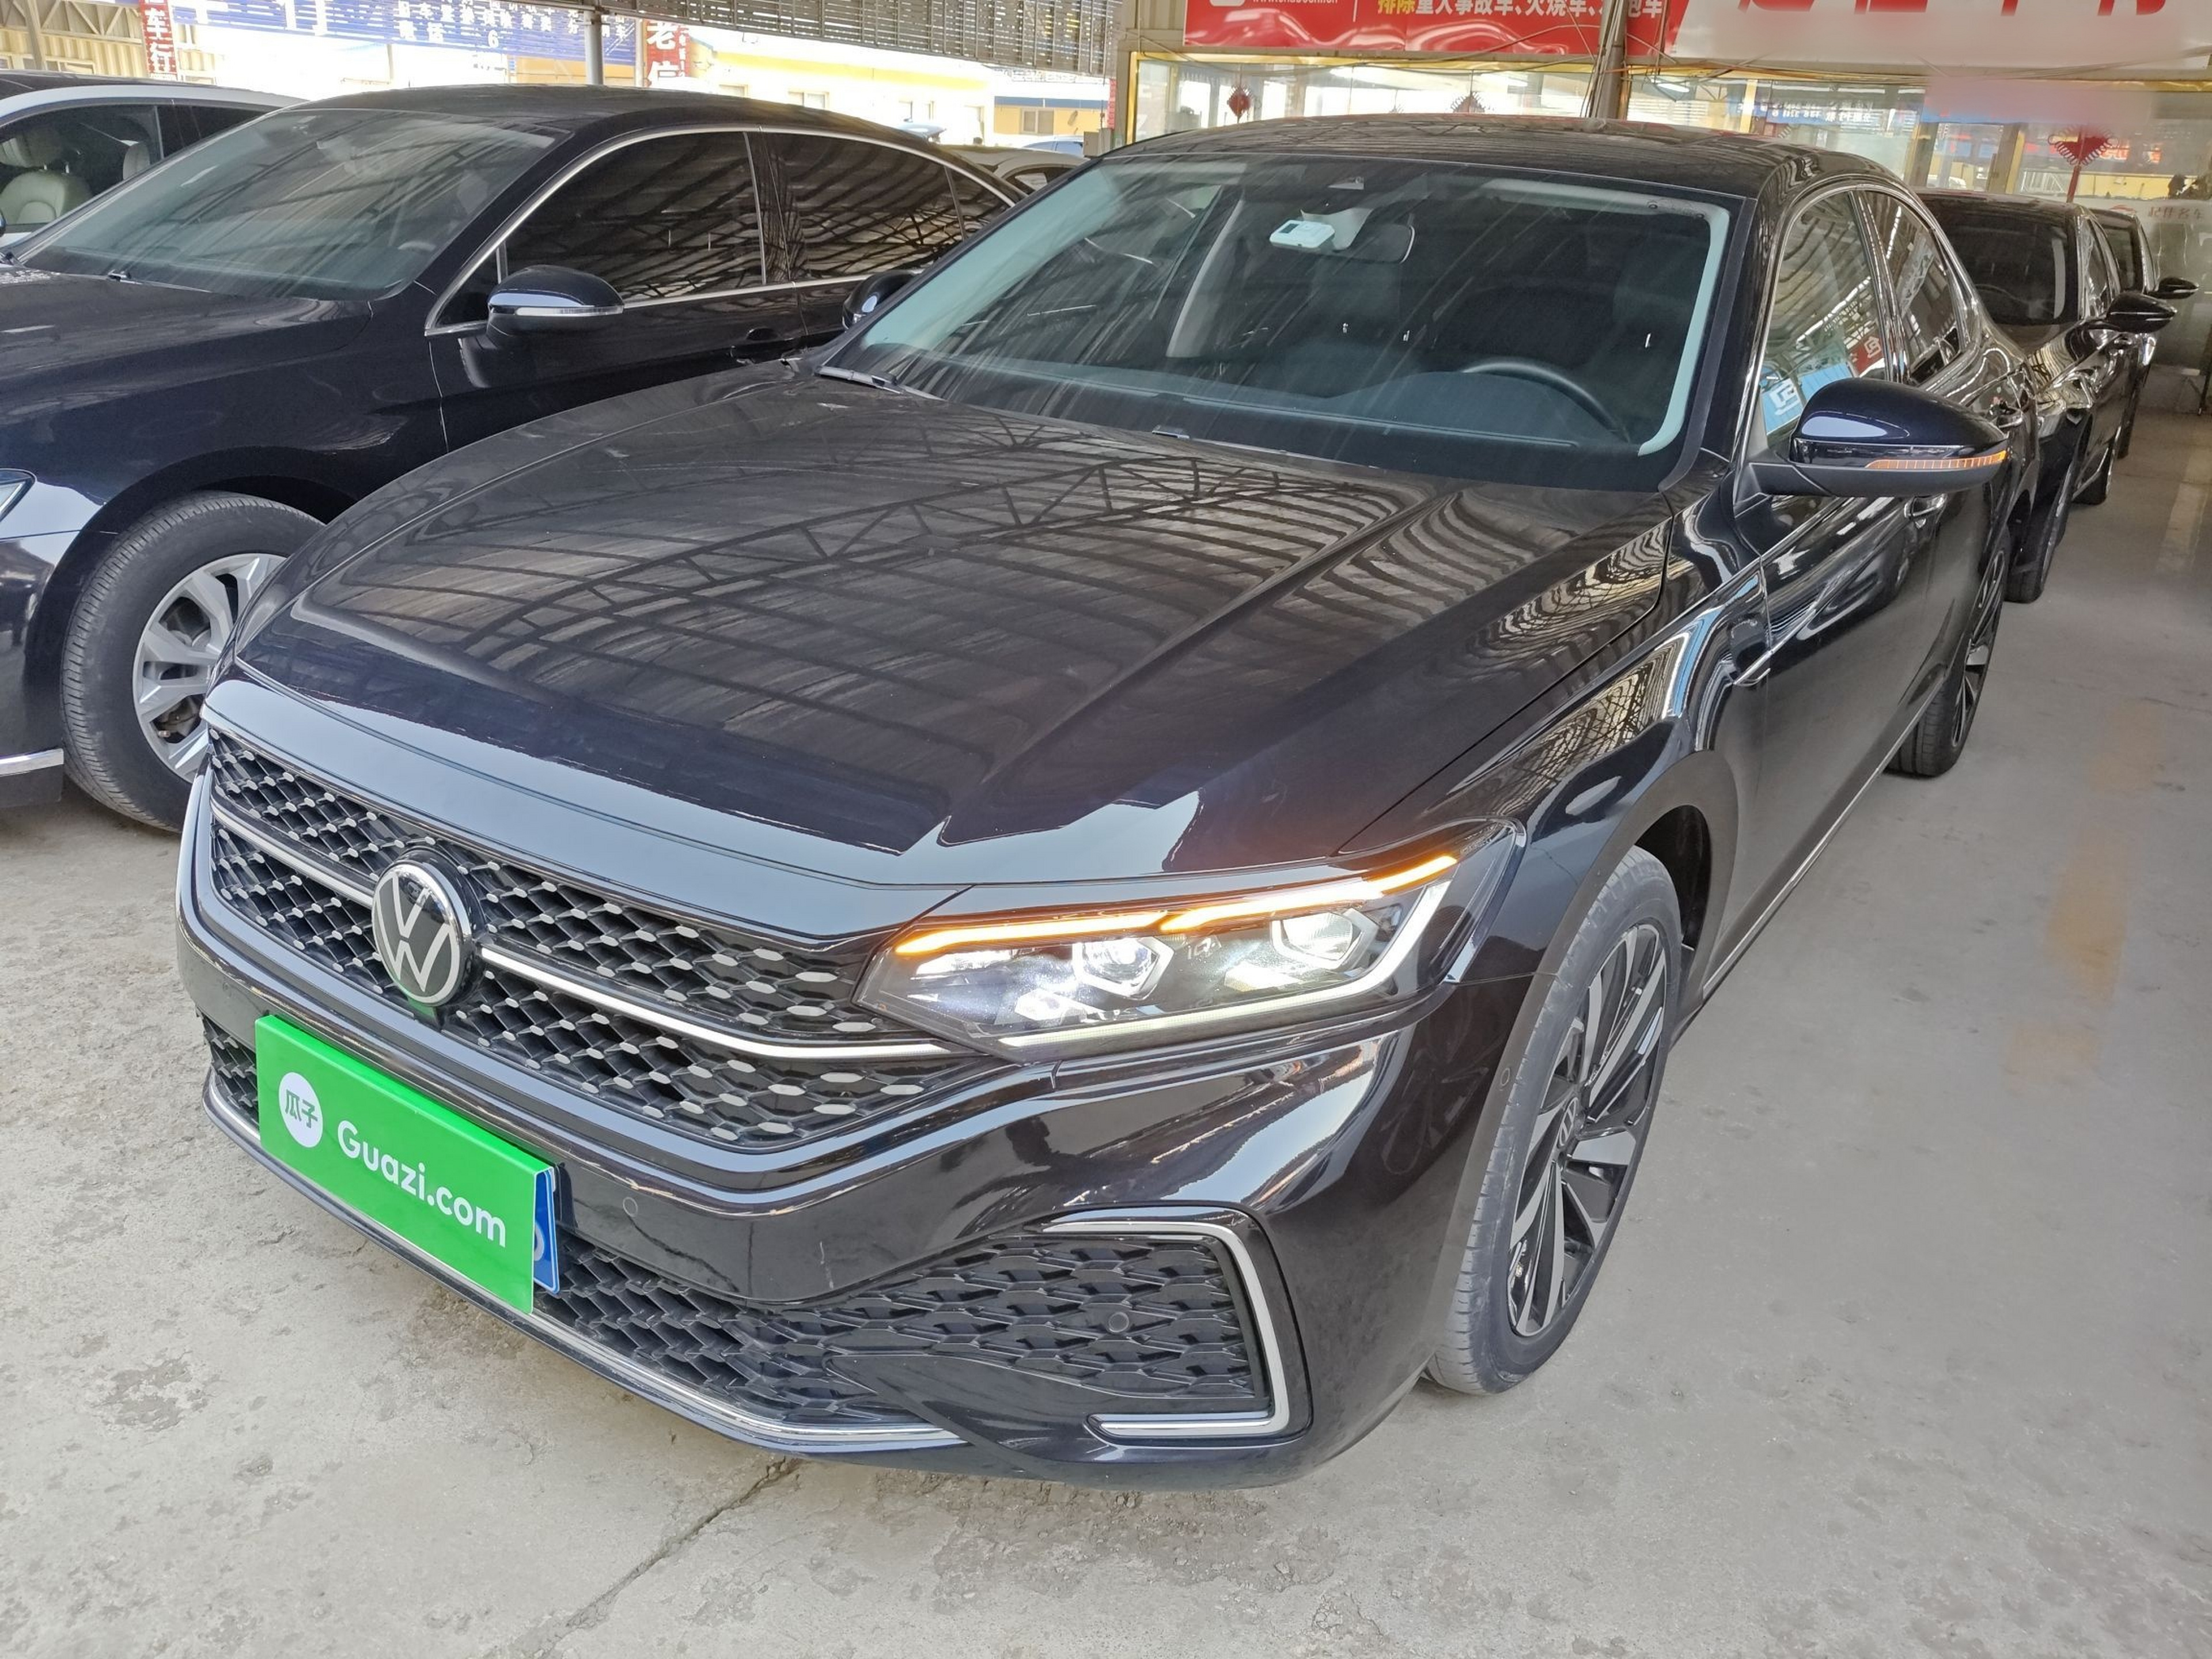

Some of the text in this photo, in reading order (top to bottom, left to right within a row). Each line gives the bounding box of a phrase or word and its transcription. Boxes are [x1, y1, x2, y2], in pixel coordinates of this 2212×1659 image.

[144, 0, 175, 73] 车行
[285, 1089, 318, 1129] 瓜子
[338, 1120, 506, 1248] Guazi.com
